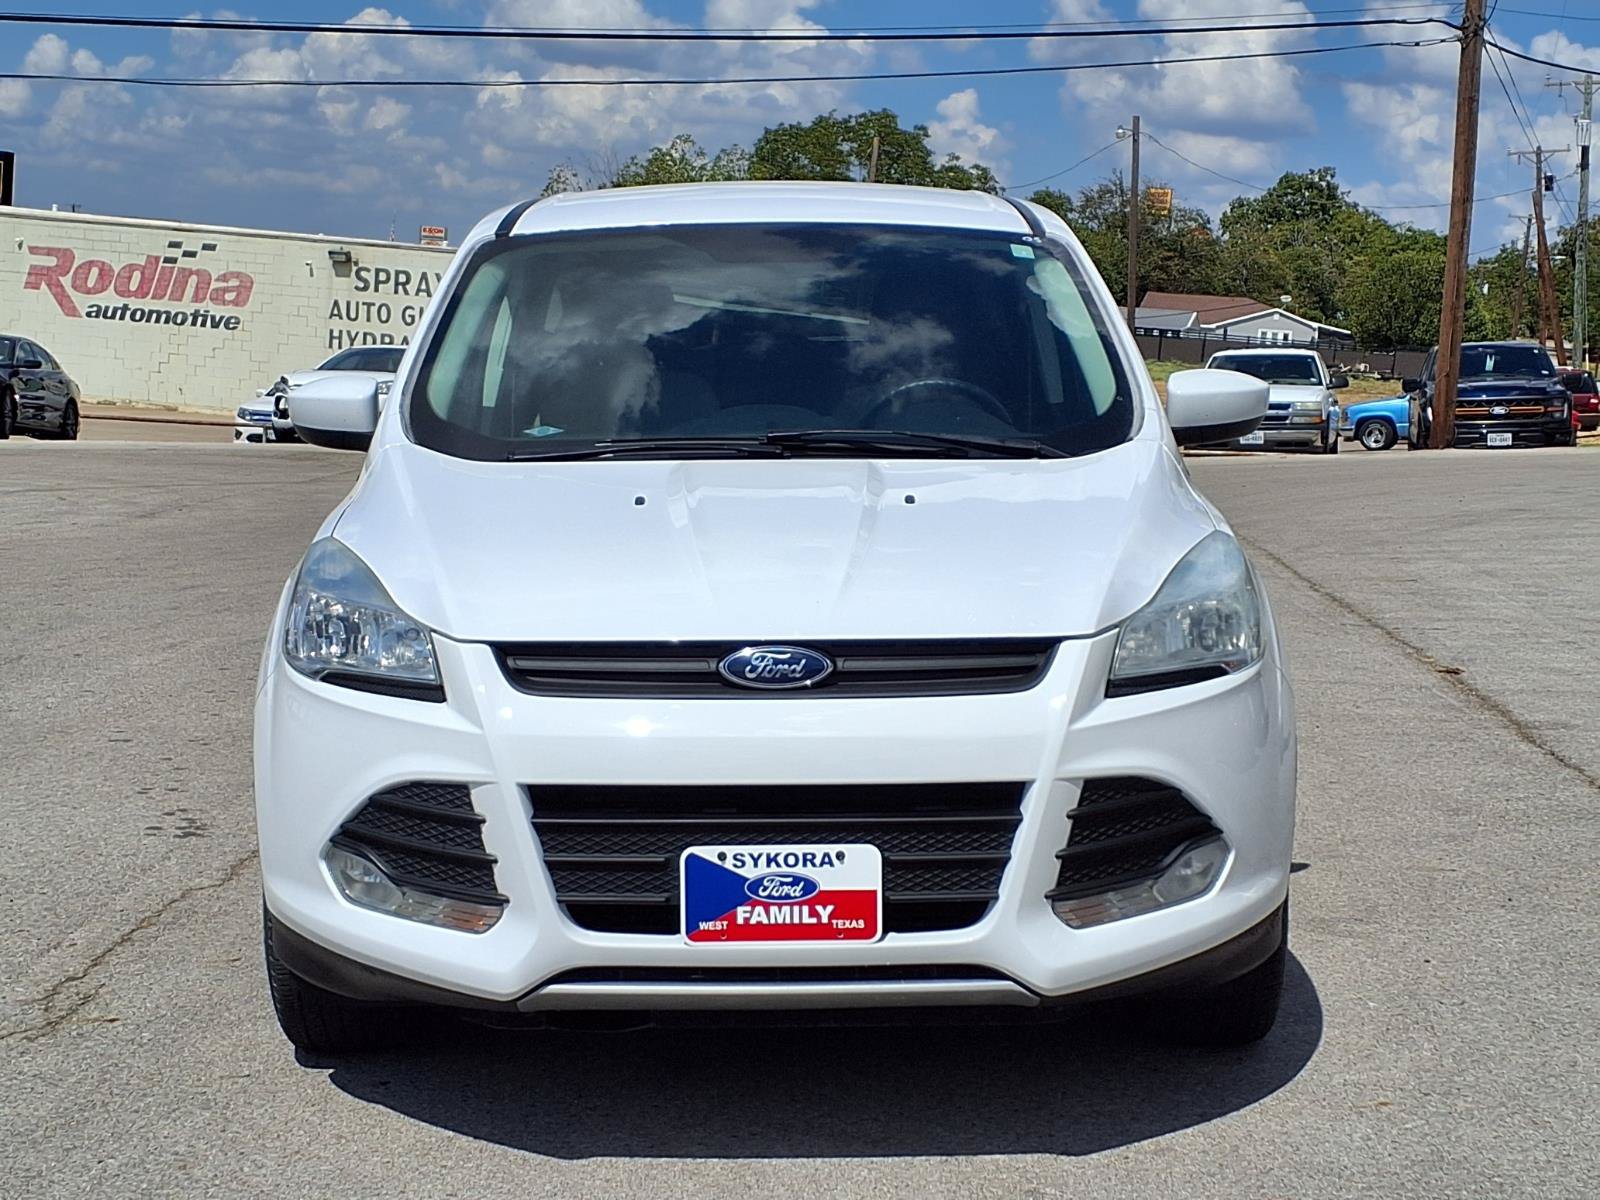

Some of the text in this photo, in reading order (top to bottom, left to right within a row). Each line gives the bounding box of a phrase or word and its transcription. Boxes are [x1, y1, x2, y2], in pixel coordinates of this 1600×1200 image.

[23, 244, 254, 319] Rodina
[85, 303, 241, 331] automotive
[328, 299, 425, 326] AUTO G
[744, 652, 806, 679] Ford
[732, 852, 835, 868] SYKORA
[758, 876, 805, 897] Ford
[698, 920, 729, 930] WEST
[736, 905, 836, 925] FAMILY
[831, 919, 865, 929] TEXAS
